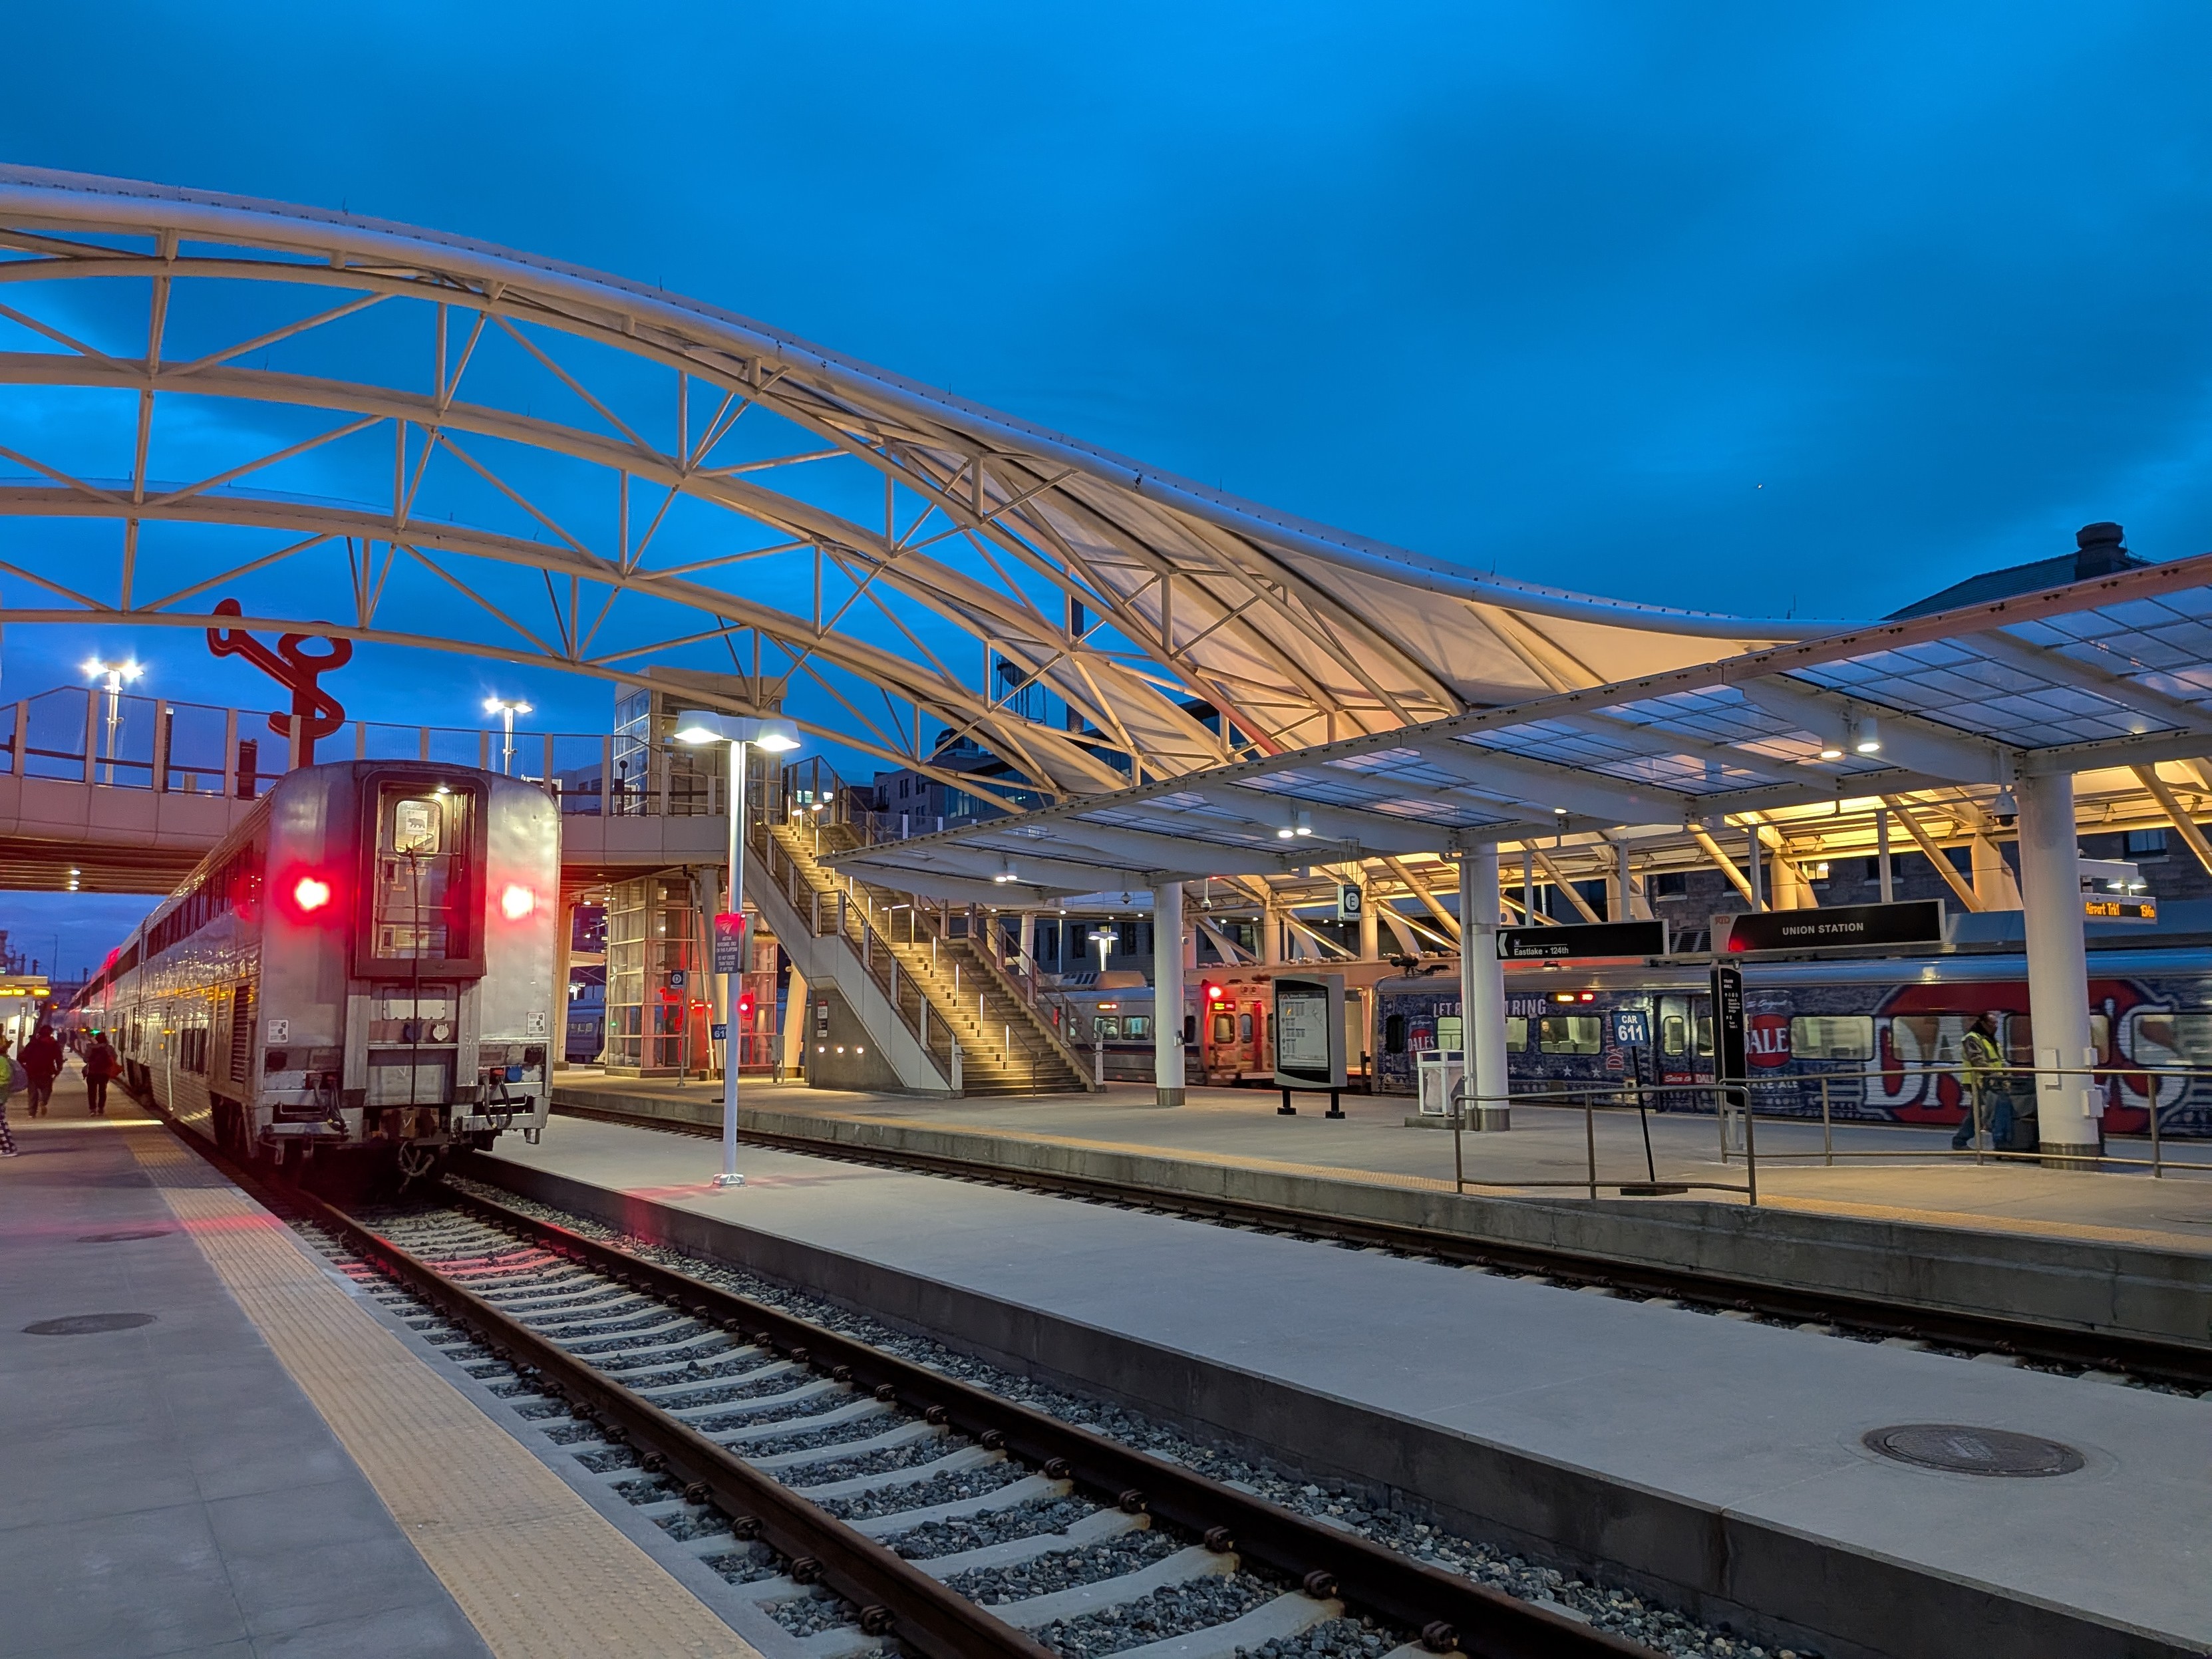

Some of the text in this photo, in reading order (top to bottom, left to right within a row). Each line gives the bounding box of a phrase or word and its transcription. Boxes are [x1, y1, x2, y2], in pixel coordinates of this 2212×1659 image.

[1350, 895, 1355, 907] E
[2086, 902, 2106, 915] Airport
[1782, 923, 1864, 935] UNION STATION
[1433, 1002, 1452, 1018] LET
[1512, 998, 1546, 1015] RING
[1621, 1015, 1638, 1024] CAR
[1618, 1025, 1643, 1041] 611
